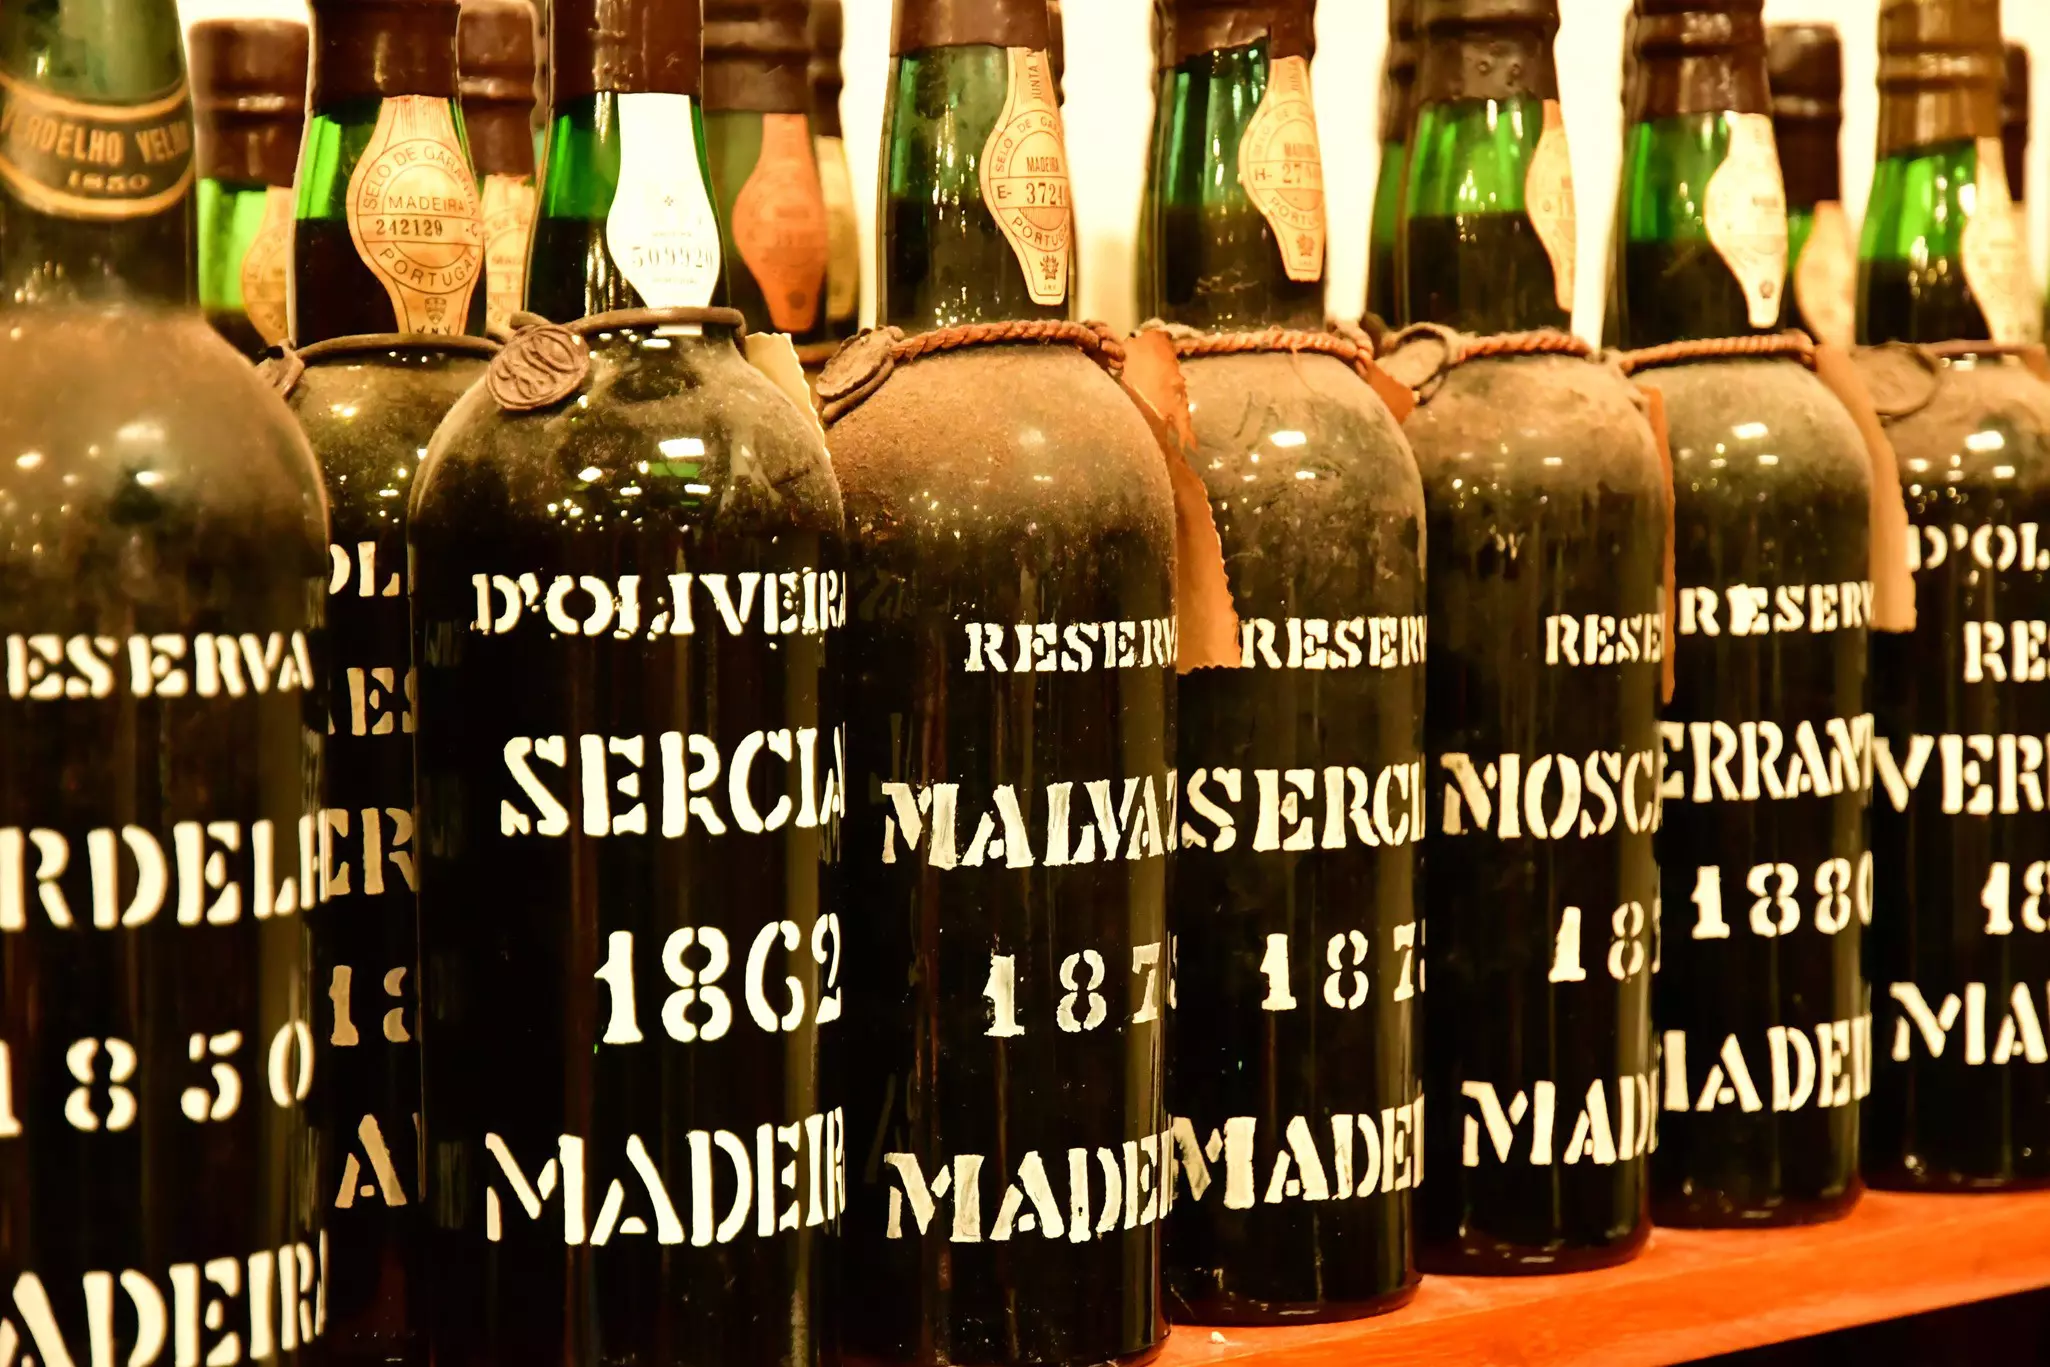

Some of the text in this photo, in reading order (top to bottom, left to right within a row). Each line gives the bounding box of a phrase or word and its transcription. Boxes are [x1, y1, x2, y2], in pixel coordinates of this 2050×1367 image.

[362, 164, 392, 210] SELO
[393, 146, 417, 167] DE
[996, 137, 1013, 172] SELO
[1017, 118, 1032, 133] DE
[1026, 156, 1060, 173] MADEIRA
[388, 195, 465, 212] MADEIRA
[379, 247, 478, 287] PORTUGAL
[1965, 620, 2050, 682] RE
[501, 723, 845, 838] SERCIA
[1182, 759, 1425, 852] SERCI
[1441, 745, 1662, 839] MOSC
[1874, 734, 2050, 815] VER
[1692, 852, 1873, 939] 1880
[594, 913, 841, 1044] 1862
[1260, 920, 1425, 1013] 187
[1548, 895, 1661, 986] 18
[983, 935, 1177, 1042] 187
[1890, 982, 2050, 1065] MA
[1462, 1065, 1659, 1166] MAD
[485, 1107, 845, 1246] MADEIR
